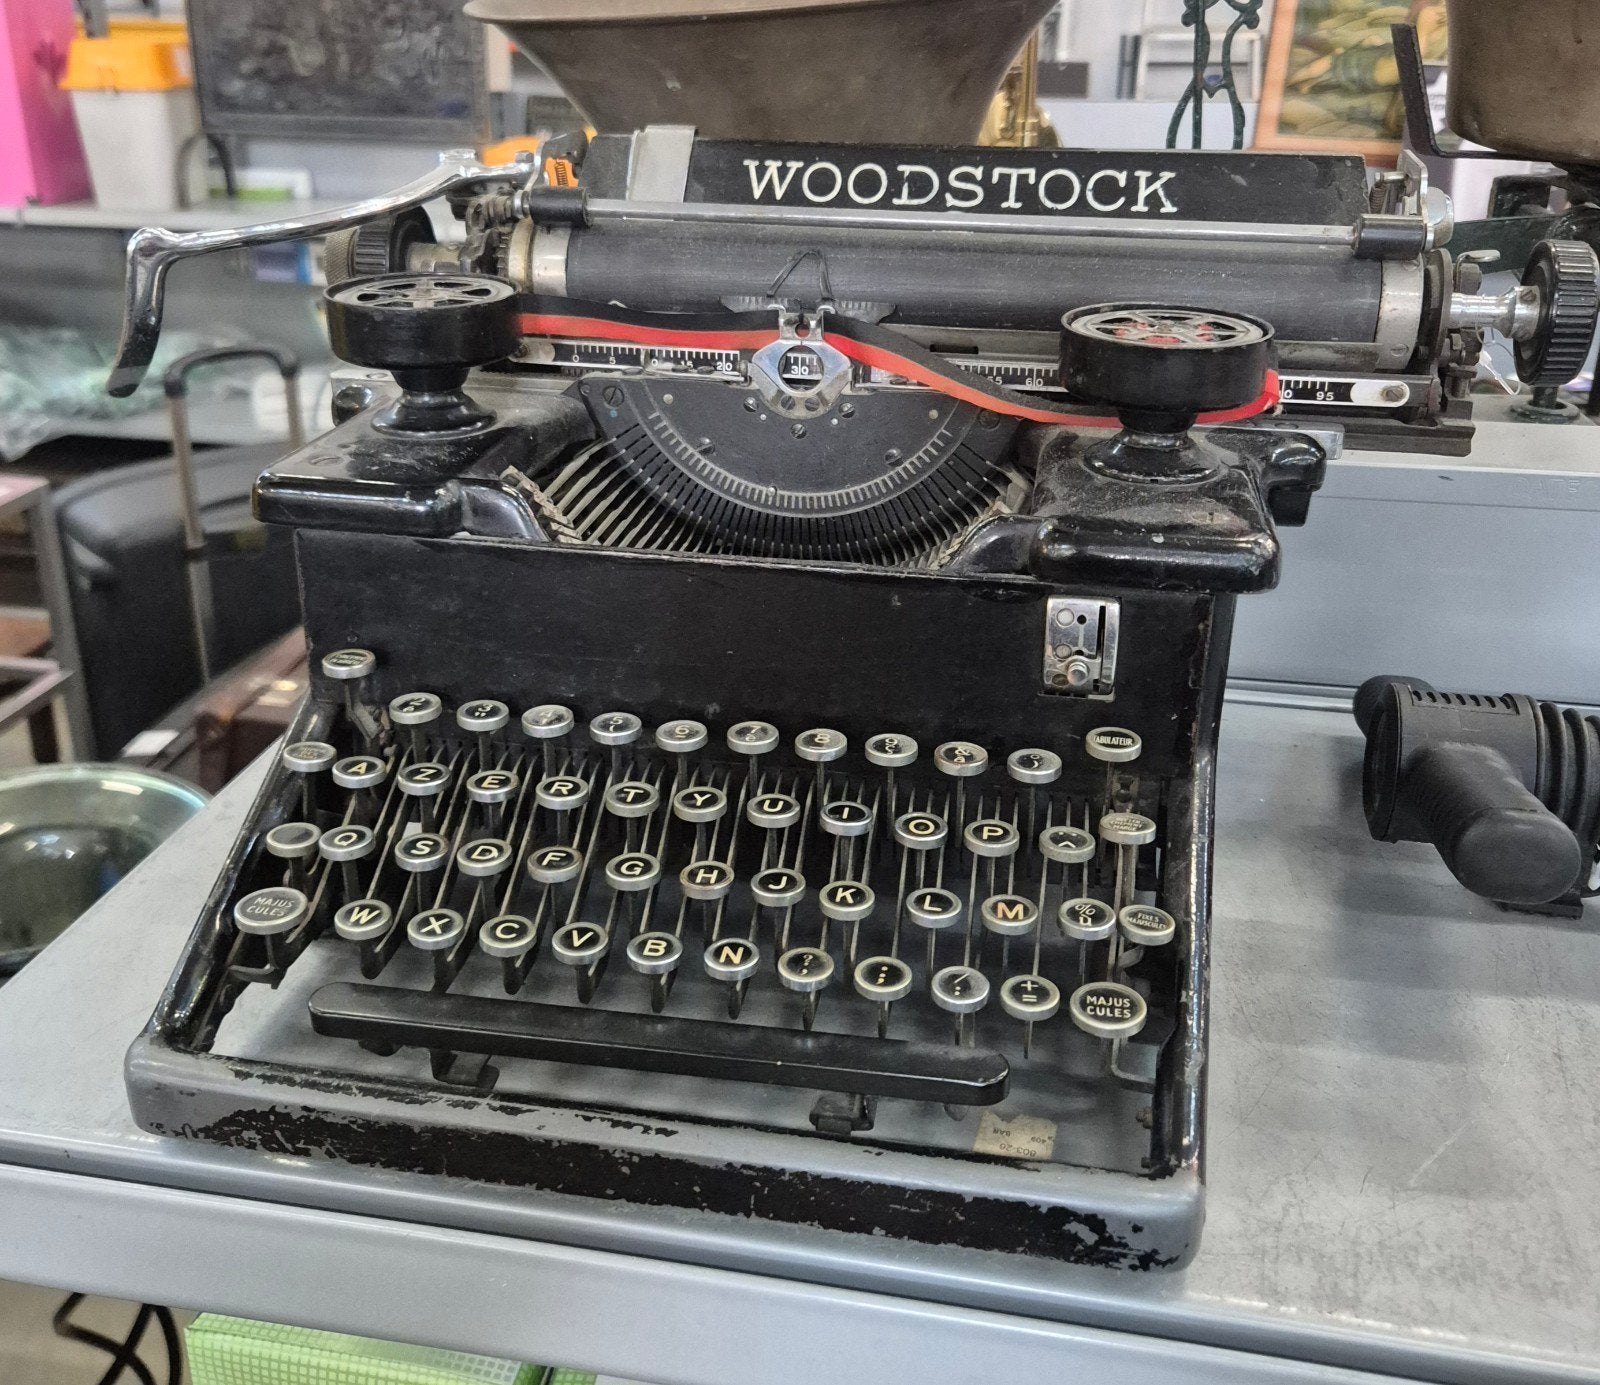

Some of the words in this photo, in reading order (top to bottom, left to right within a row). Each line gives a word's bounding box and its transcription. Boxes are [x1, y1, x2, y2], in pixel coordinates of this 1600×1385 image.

[743, 159, 1178, 213] WOODSTOCK
[572, 354, 580, 363] 0
[608, 356, 616, 365] 5
[717, 362, 733, 371] 20
[791, 365, 809, 375] 30
[1025, 378, 1044, 387] 60
[1316, 391, 1334, 401] 95
[476, 703, 493, 713] 3
[609, 716, 624, 725] 5
[674, 725, 690, 735] 6
[750, 725, 762, 734] 7
[814, 733, 831, 744] 8
[885, 737, 898, 747] 9
[346, 762, 368, 775] A
[412, 768, 437, 781] Z
[480, 775, 506, 789] E
[550, 781, 574, 795] R
[623, 788, 644, 802] T
[693, 793, 712, 807] Y
[762, 800, 784, 812] U
[842, 807, 849, 819] I
[908, 819, 935, 835] O
[982, 826, 1004, 840] P
[334, 831, 358, 846] Q
[410, 840, 434, 855] S
[470, 845, 499, 860] D
[541, 852, 567, 866] F
[620, 860, 645, 876] G
[695, 868, 719, 884] H
[768, 876, 788, 890] J
[253, 896, 295, 908] MAJUS
[835, 887, 857, 904] K
[922, 894, 943, 912] L
[246, 905, 285, 917] CULES
[349, 906, 381, 925] W
[997, 902, 1024, 921] M
[420, 916, 450, 934] X
[495, 922, 520, 939] C
[572, 929, 594, 948] V
[642, 939, 668, 957] B
[719, 945, 744, 965] N
[1086, 995, 1131, 1008] MAJUS
[1086, 1006, 1132, 1019] CULES
